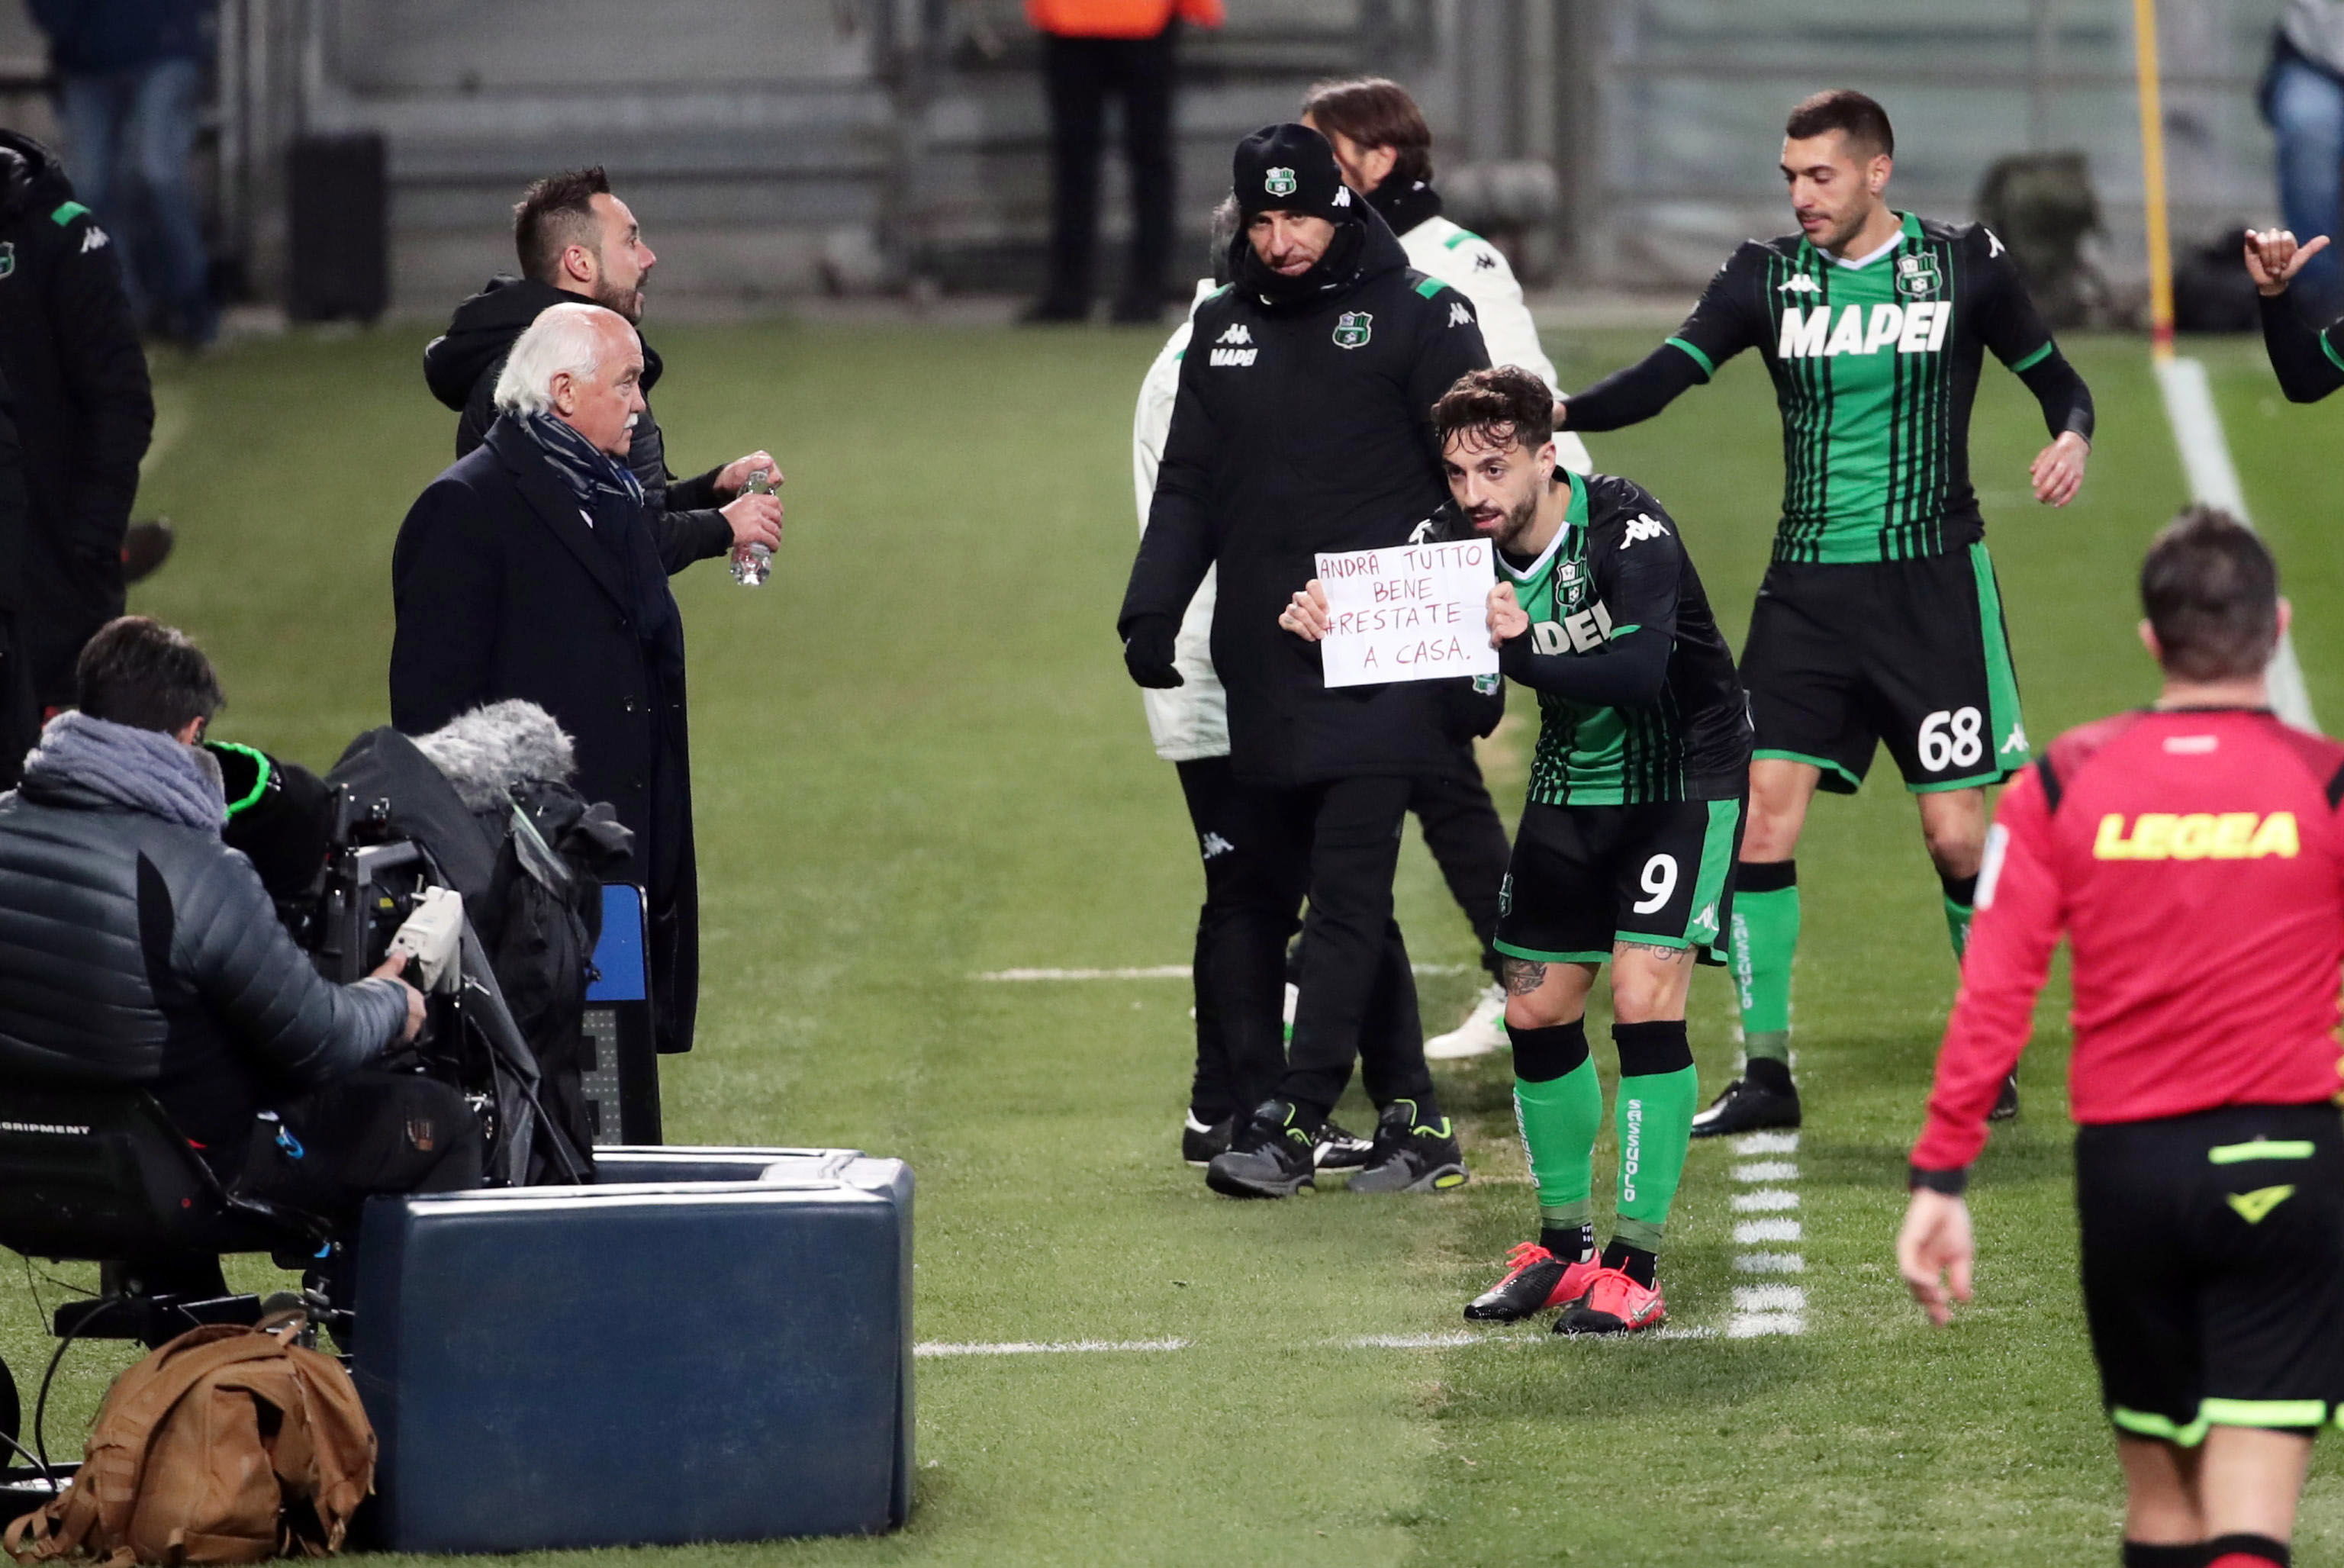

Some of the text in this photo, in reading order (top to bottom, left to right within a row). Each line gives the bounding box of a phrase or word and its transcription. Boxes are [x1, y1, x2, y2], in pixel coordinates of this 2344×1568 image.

[1778, 301, 1952, 359] MAPEI
[1209, 348, 1258, 366] MAPEI
[1403, 545, 1483, 571] TUTTO
[1373, 577, 1434, 603] BENE
[1364, 635, 1471, 669] A CASA.
[1917, 706, 1982, 772] 68
[2092, 811, 2301, 861] LEGEA
[1633, 853, 1678, 914] 9
[0, 1121, 91, 1135] GRIPMENT
[1624, 1099, 1642, 1203] SASSUOLO
